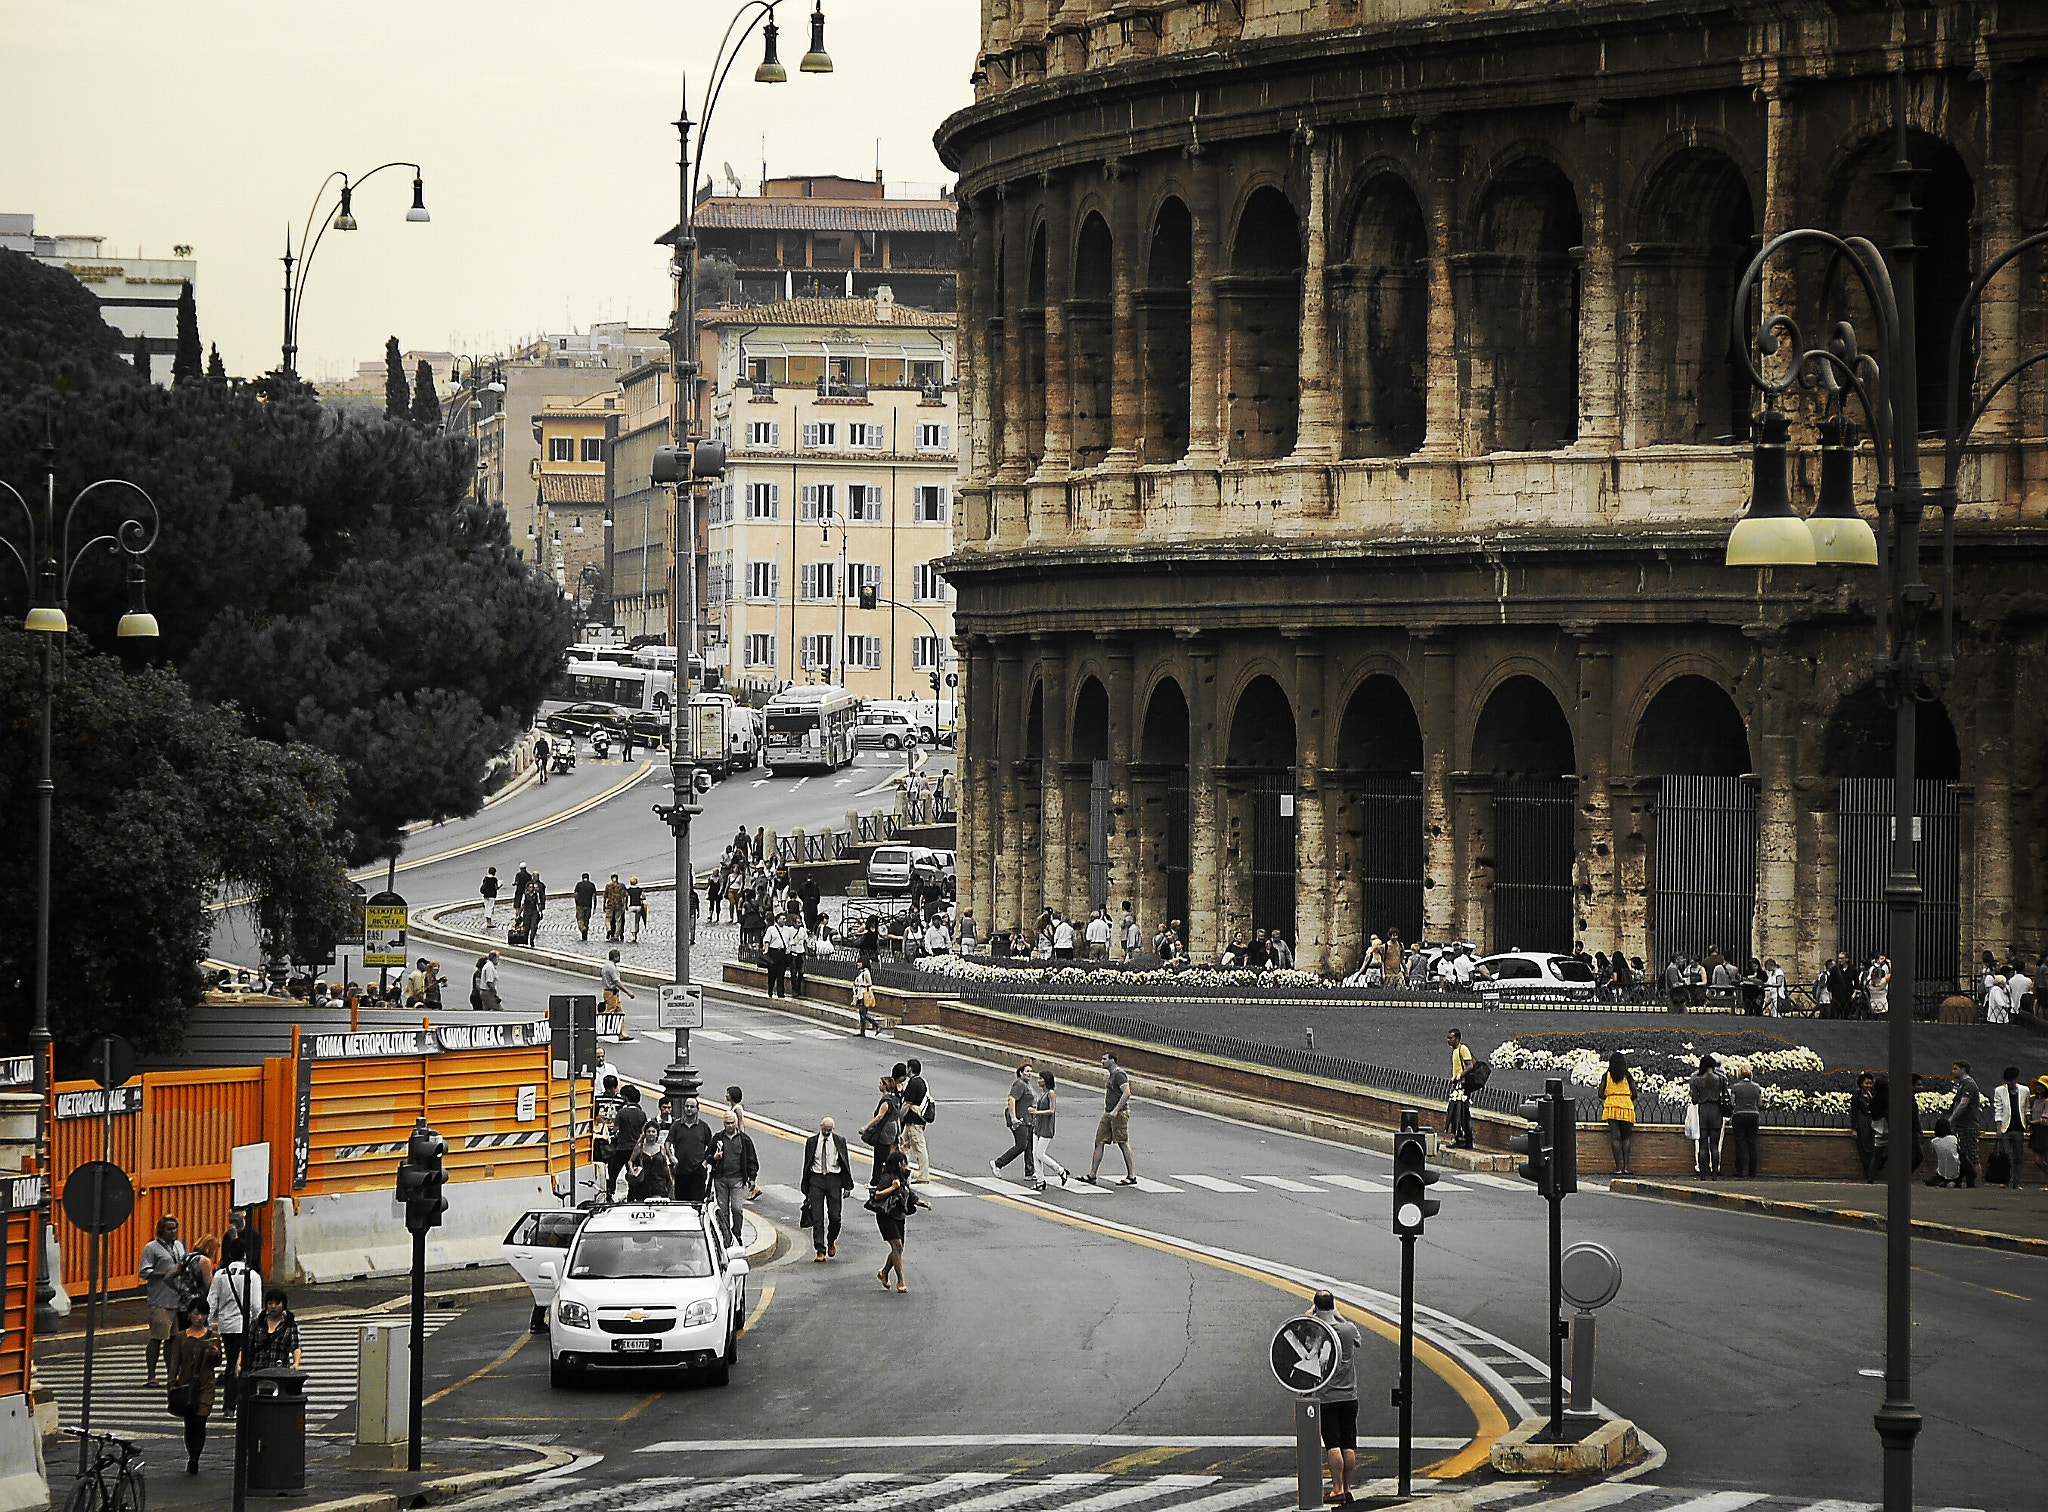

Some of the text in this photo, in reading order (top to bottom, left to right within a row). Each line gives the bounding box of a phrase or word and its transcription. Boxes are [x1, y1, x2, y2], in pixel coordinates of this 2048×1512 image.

[316, 1033, 418, 1057] ROMA METROPOLITANE
[441, 1026, 504, 1048] LAVORI LINEA C
[632, 1211, 655, 1219] TAXI
